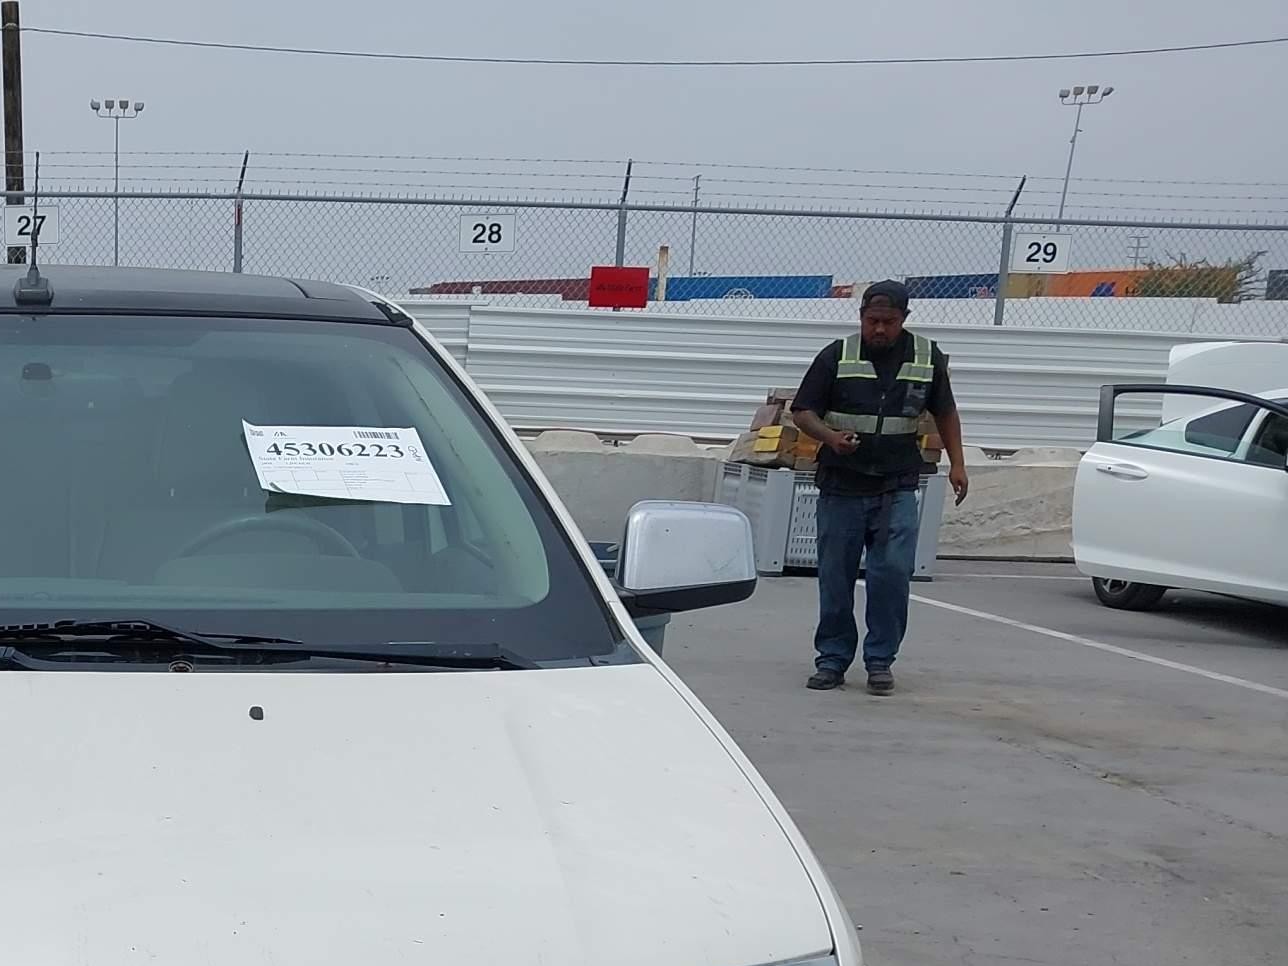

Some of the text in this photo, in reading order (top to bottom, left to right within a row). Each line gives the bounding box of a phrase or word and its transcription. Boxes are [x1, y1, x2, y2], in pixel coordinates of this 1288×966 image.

[17, 215, 46, 236] 27
[472, 223, 502, 243] 28
[1026, 242, 1057, 263] 29
[266, 442, 404, 458] 45306223
